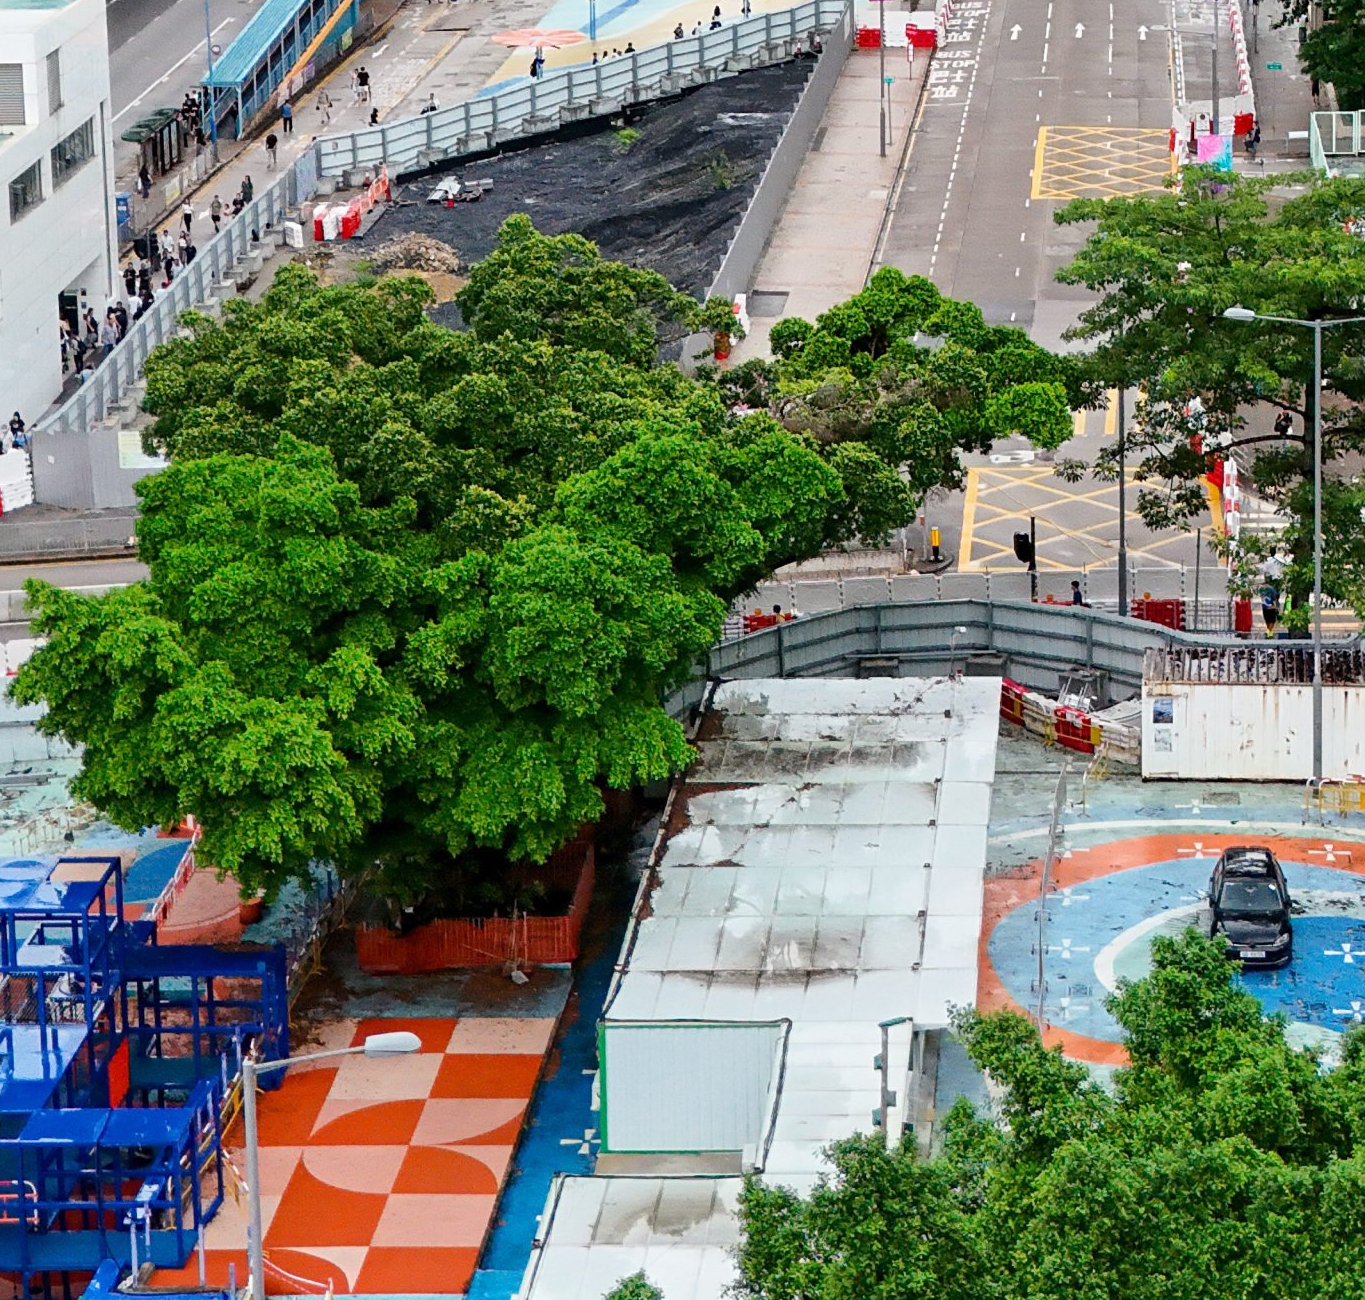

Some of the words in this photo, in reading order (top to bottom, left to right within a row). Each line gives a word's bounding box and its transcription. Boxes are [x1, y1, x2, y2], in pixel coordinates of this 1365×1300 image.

[935, 50, 973, 59] BUS
[930, 59, 976, 69] STOP
[929, 70, 969, 84] 巴士
[930, 84, 959, 99] 站
